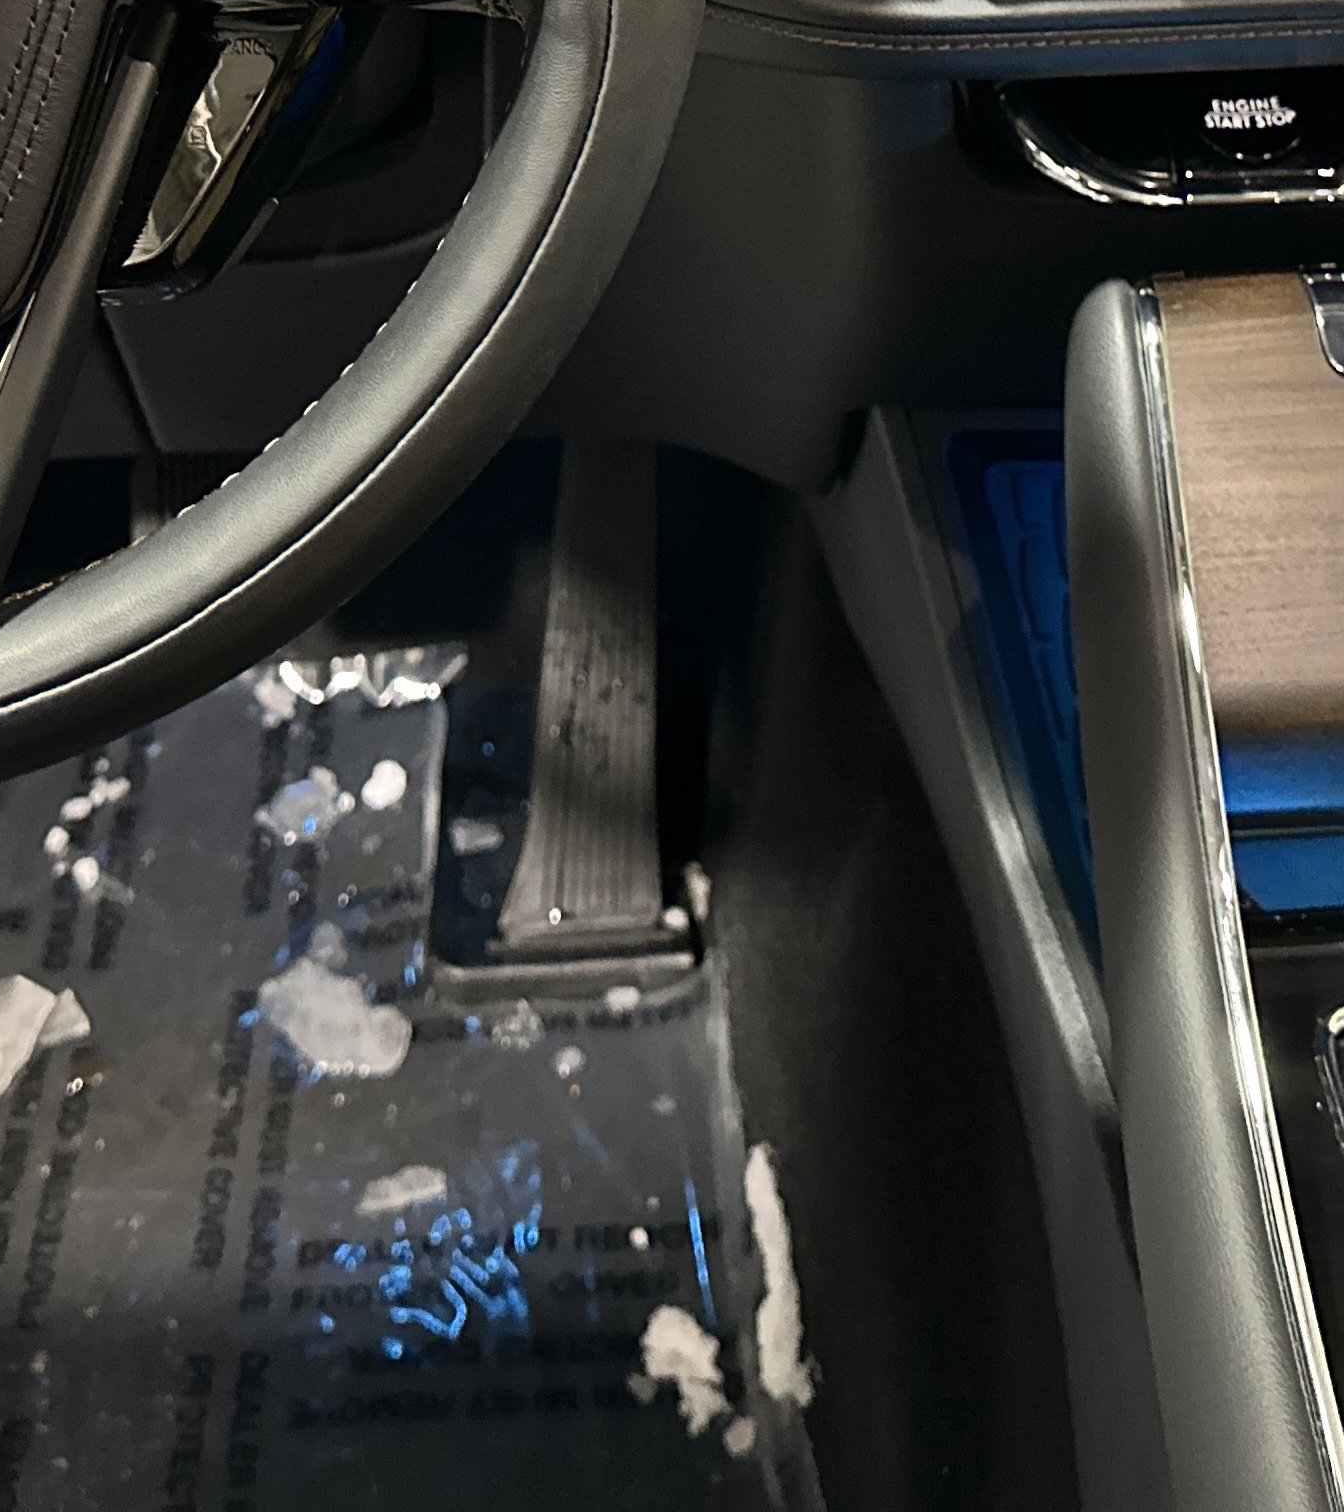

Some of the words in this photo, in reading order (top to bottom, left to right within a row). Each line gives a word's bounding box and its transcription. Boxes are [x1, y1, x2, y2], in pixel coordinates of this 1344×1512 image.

[1211, 95, 1281, 114] ENGINE
[1204, 111, 1252, 129] START
[1254, 109, 1297, 129] STOP
